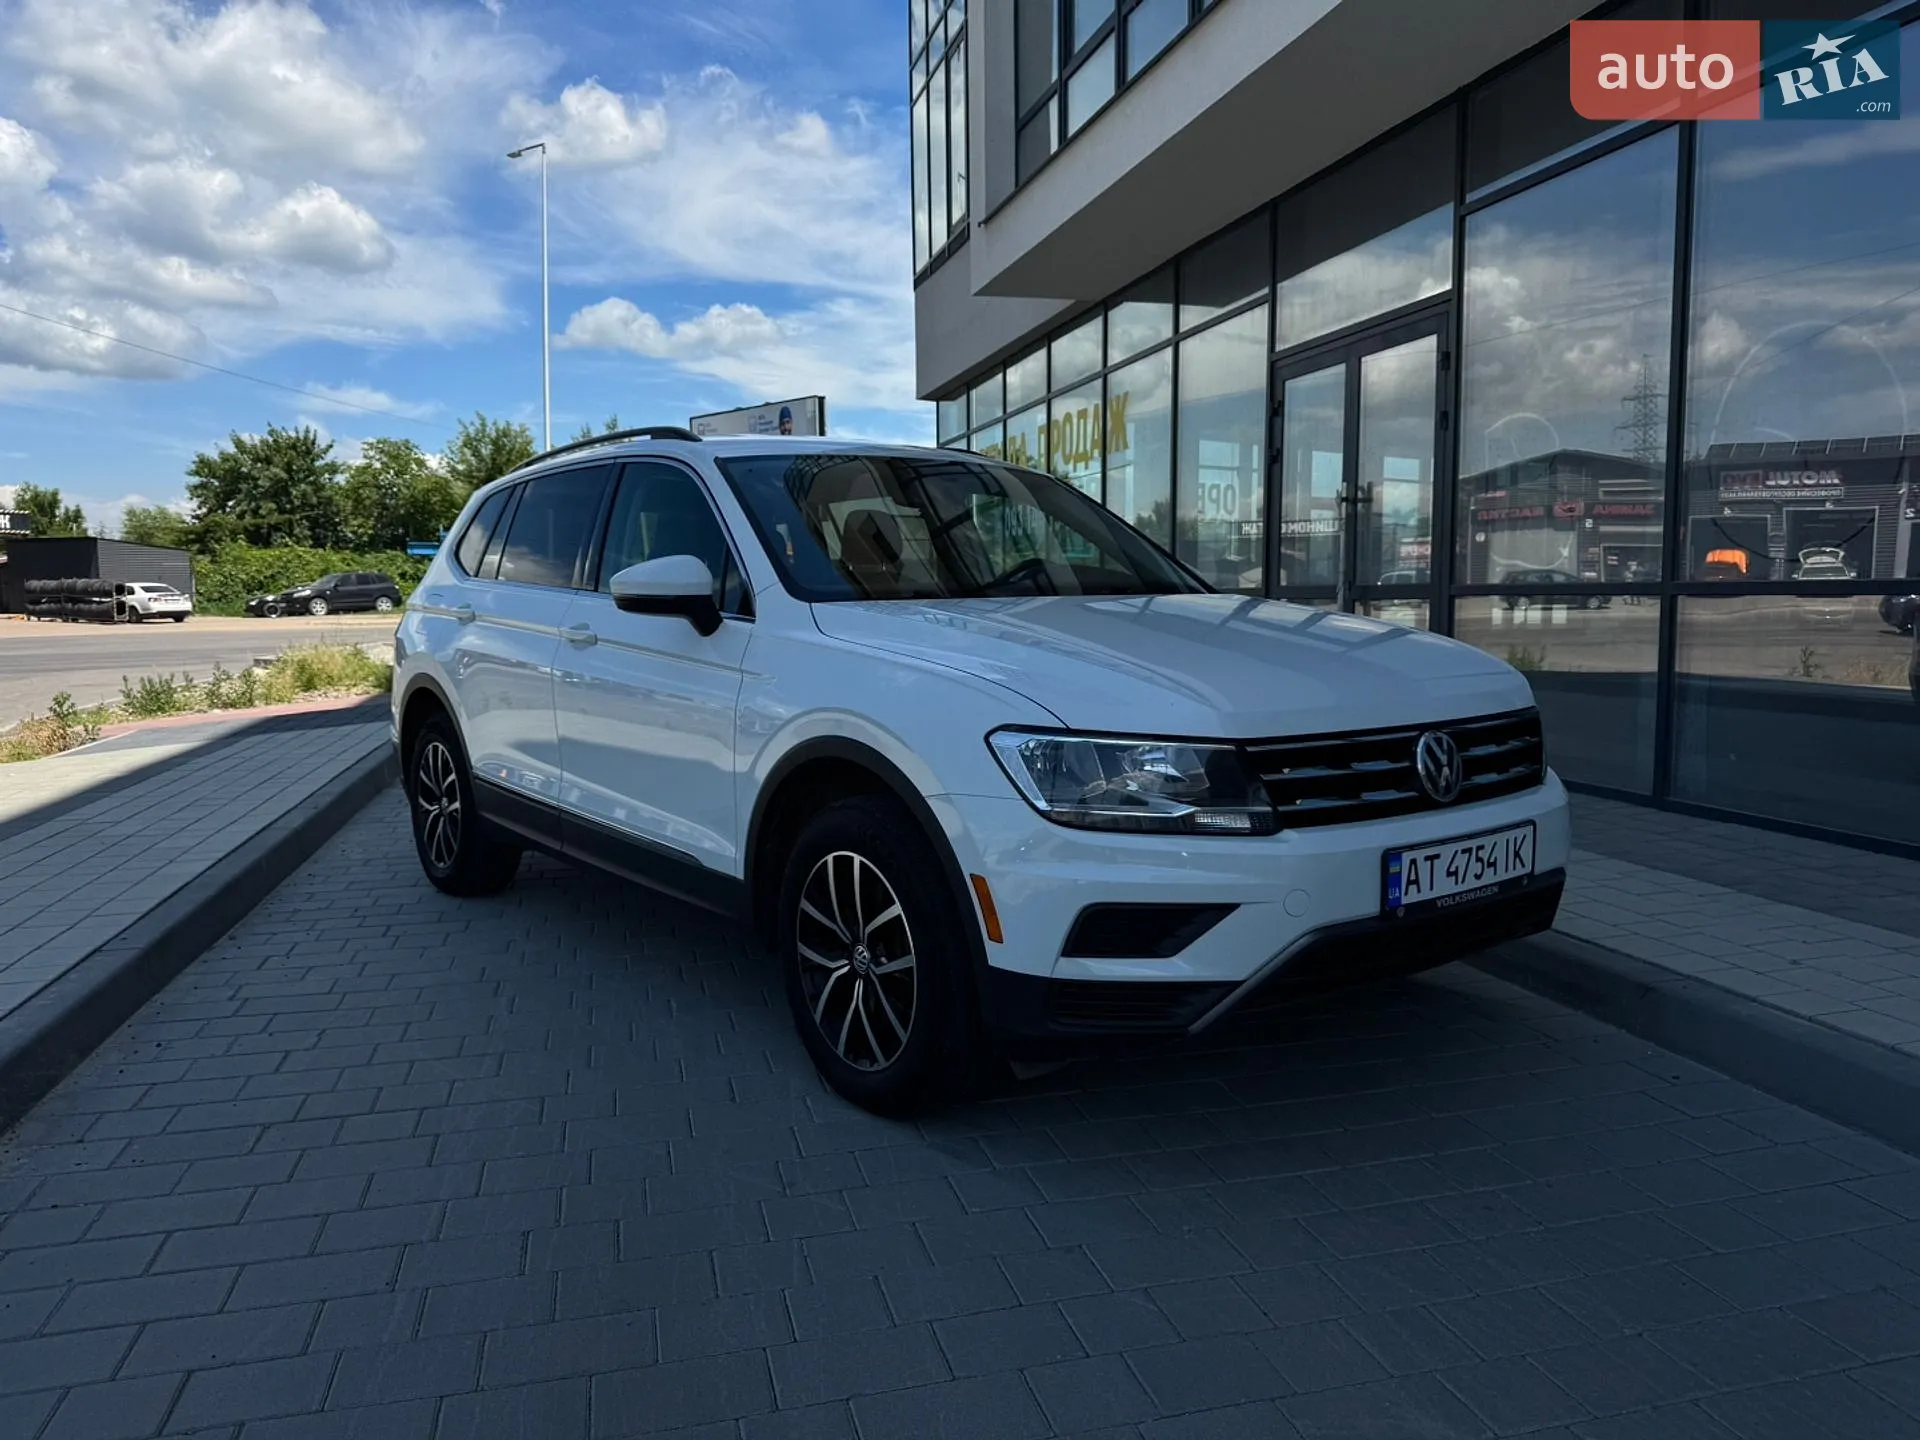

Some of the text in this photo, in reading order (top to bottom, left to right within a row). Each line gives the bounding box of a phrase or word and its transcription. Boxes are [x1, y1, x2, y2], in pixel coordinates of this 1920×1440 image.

[1037, 391, 1130, 470] ПРОДАЖ
[1404, 833, 1527, 896] AT 4754 IK
[1436, 885, 1500, 908] VOLKSWAGEN
